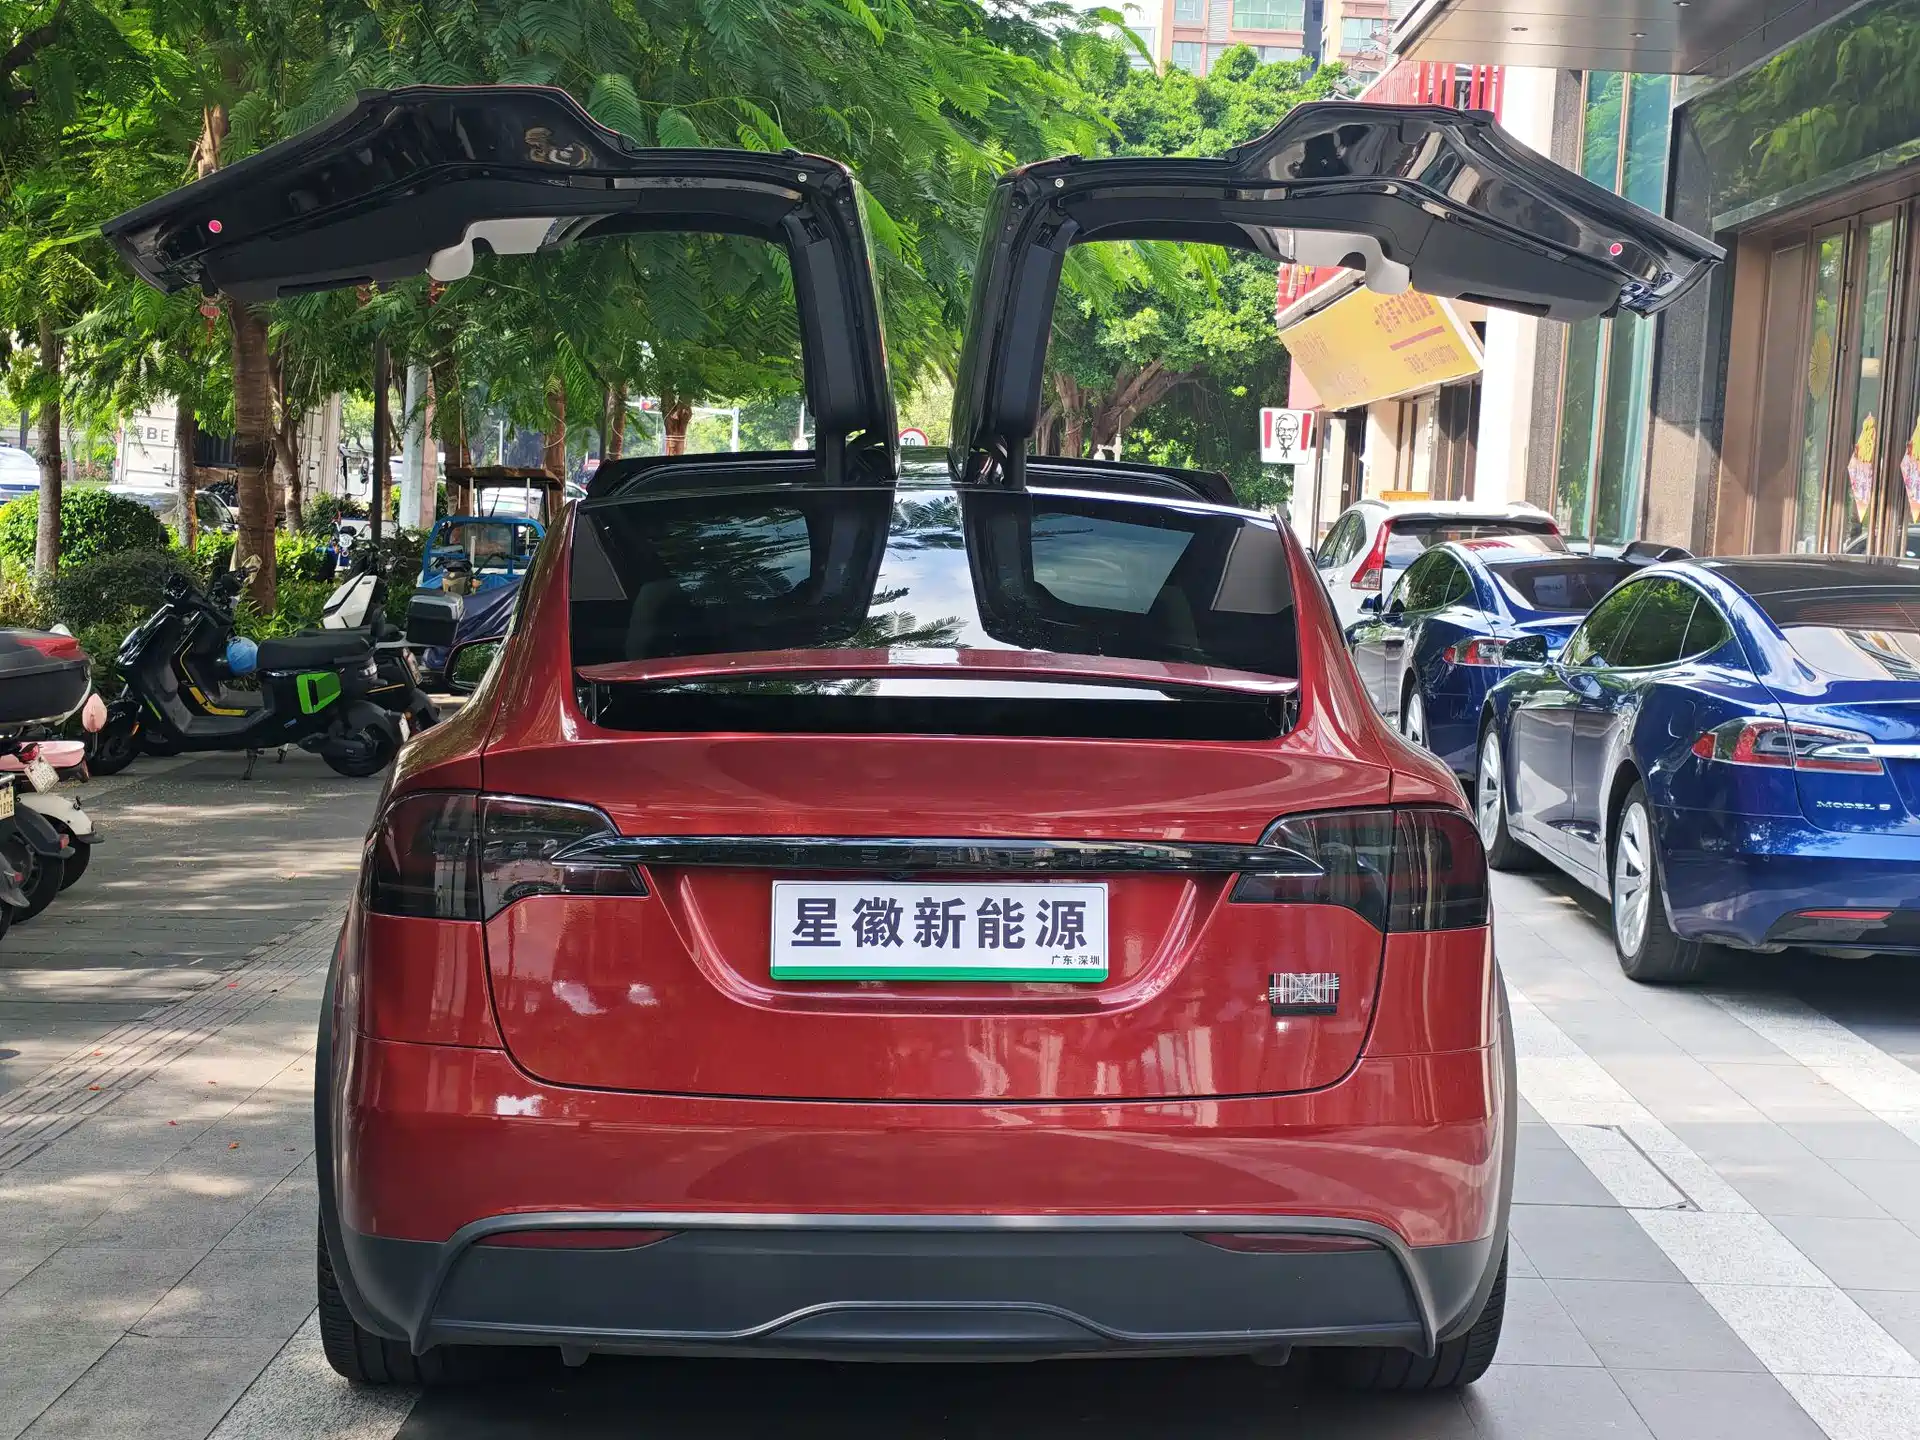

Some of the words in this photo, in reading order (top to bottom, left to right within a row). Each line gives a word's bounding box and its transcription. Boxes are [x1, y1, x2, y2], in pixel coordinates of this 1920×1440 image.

[1816, 801, 1875, 810] MODEL
[791, 897, 1087, 950] 星徽新能源
